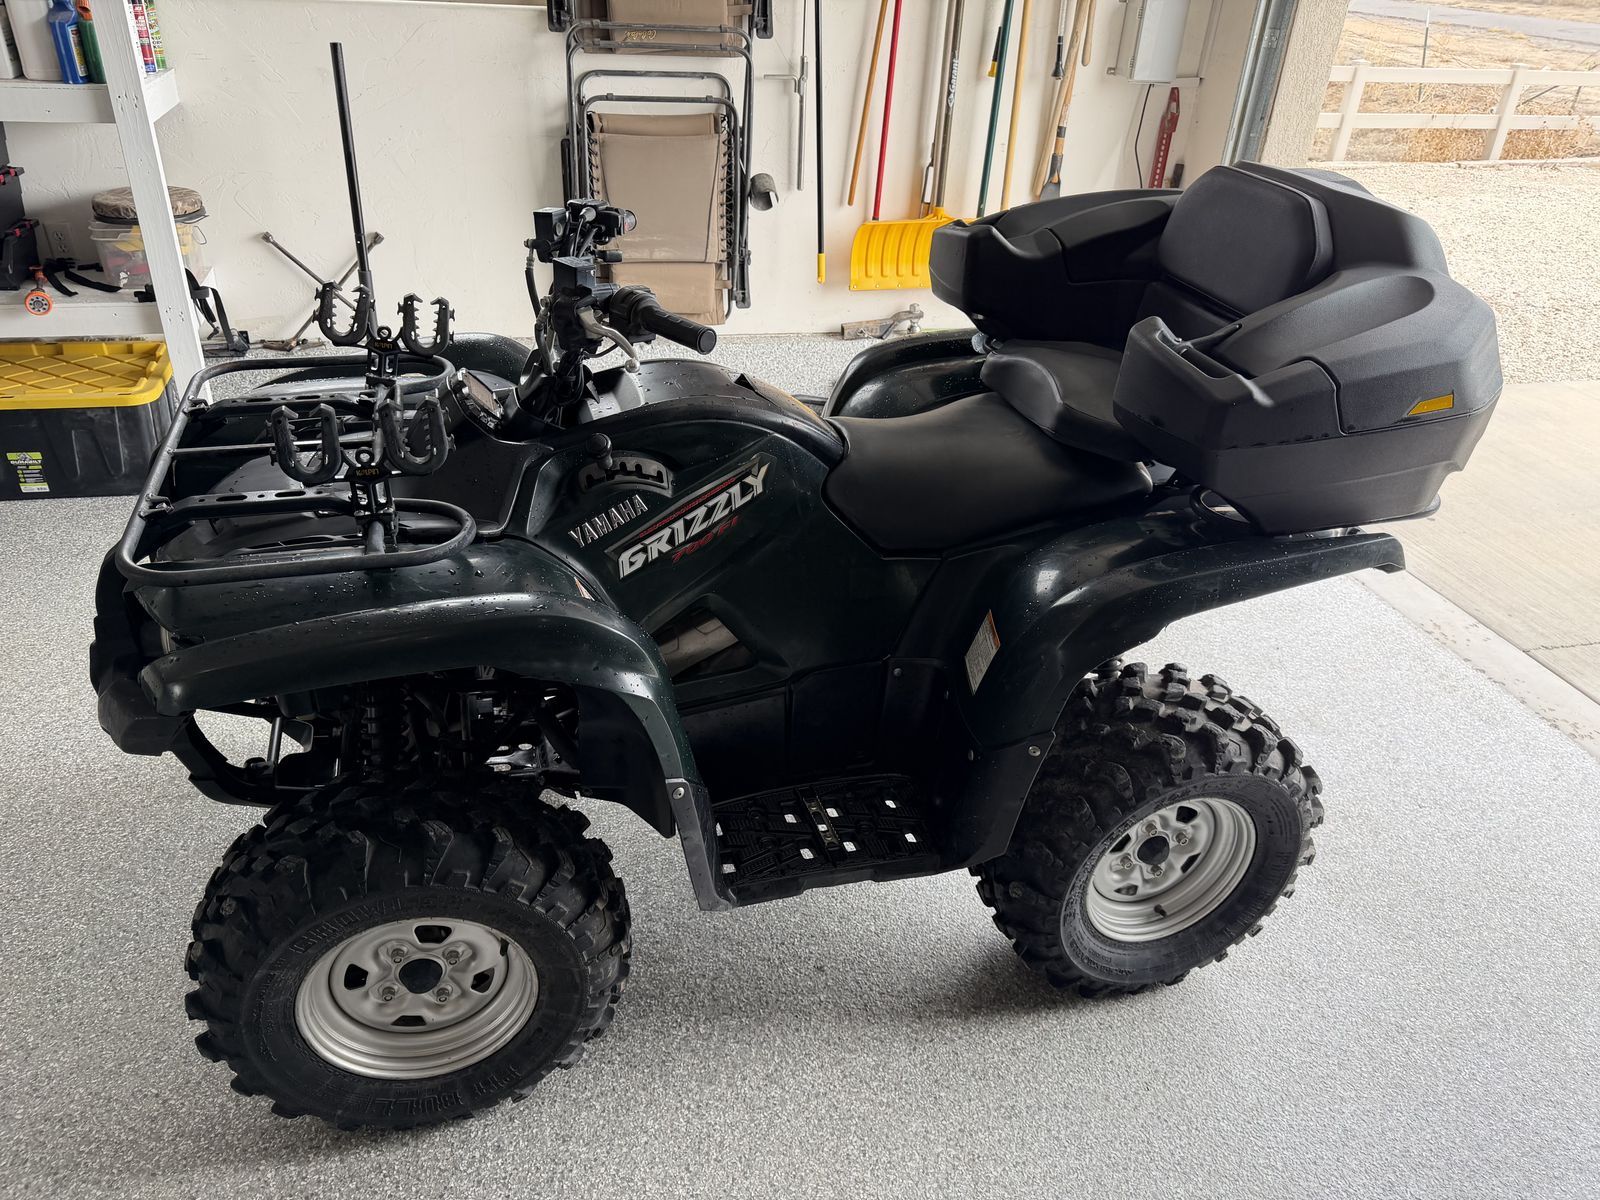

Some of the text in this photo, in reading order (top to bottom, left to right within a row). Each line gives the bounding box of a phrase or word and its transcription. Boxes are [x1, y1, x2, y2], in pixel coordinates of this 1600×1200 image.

[949, 56, 959, 93] Garant
[568, 494, 649, 549] YAMAHA
[618, 462, 770, 581] GRIZZLY
[671, 514, 741, 564] 700 FI
